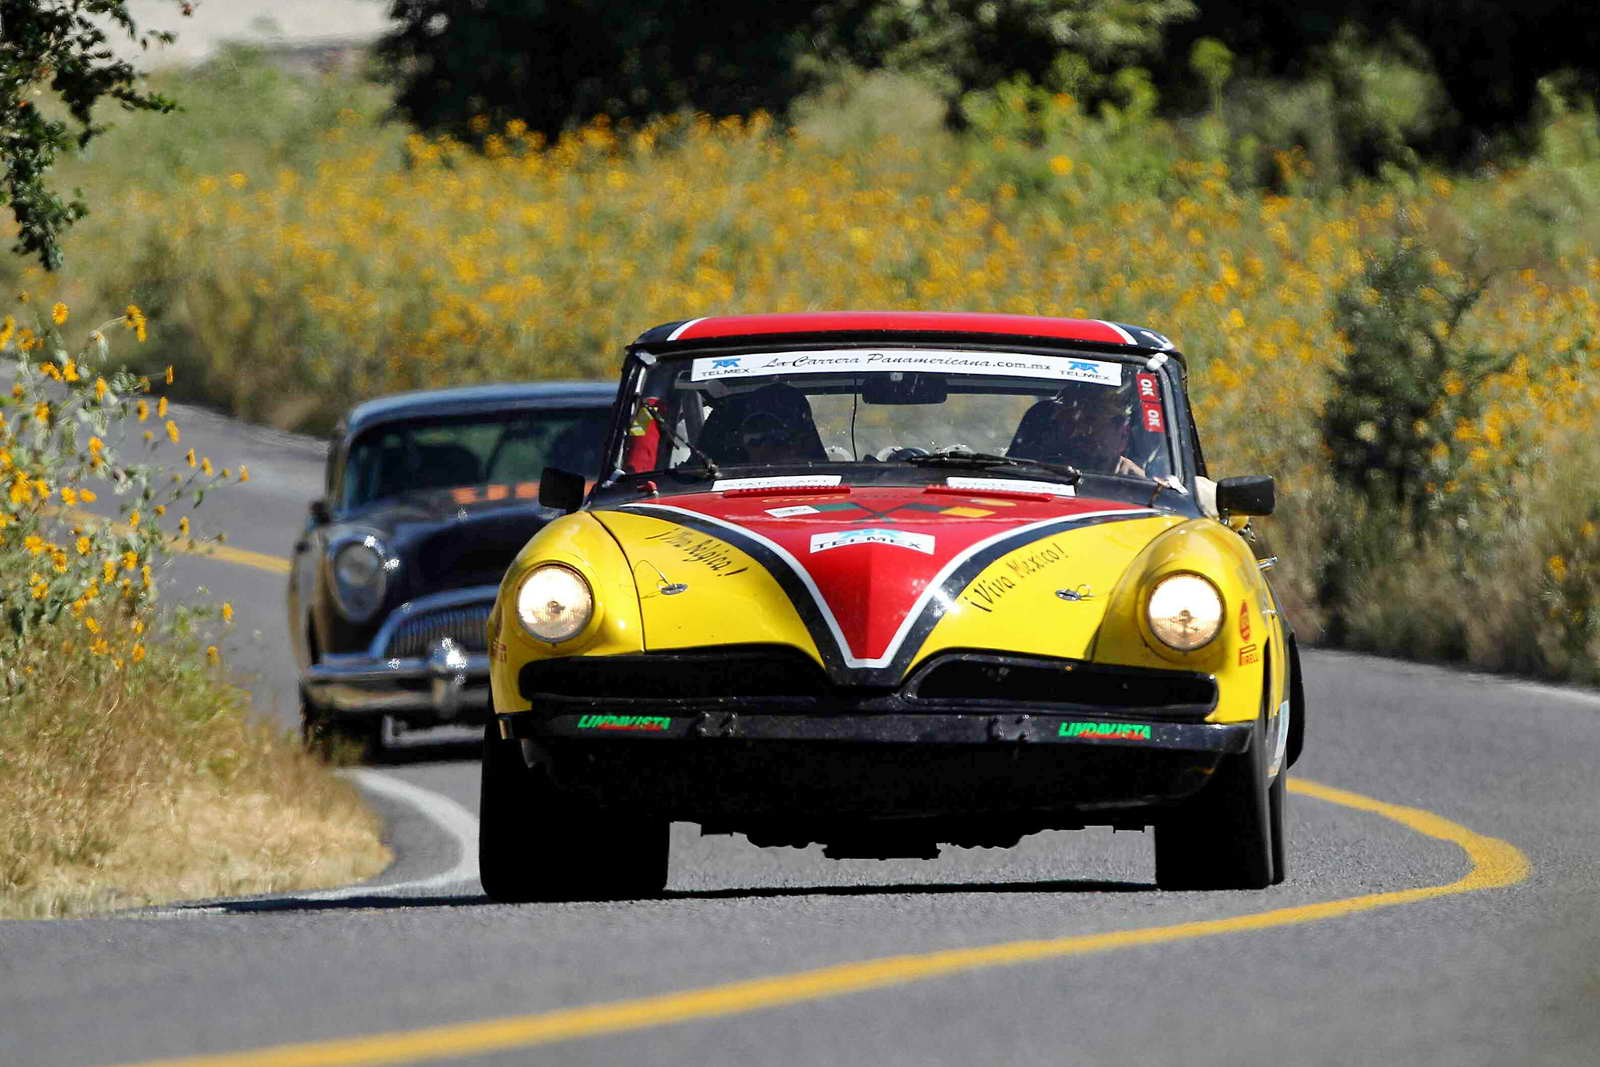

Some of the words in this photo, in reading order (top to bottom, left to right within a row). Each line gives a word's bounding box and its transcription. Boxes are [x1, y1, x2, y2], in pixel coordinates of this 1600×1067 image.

[761, 357, 787, 369] La
[791, 354, 860, 368] Carrera
[866, 352, 1051, 371] Panamericana.com.mx
[701, 369, 750, 377] TELMEX
[1058, 369, 1111, 381] TELMEX
[1140, 378, 1154, 396] OK
[1147, 409, 1161, 427] OK
[814, 535, 921, 550] TELMEX
